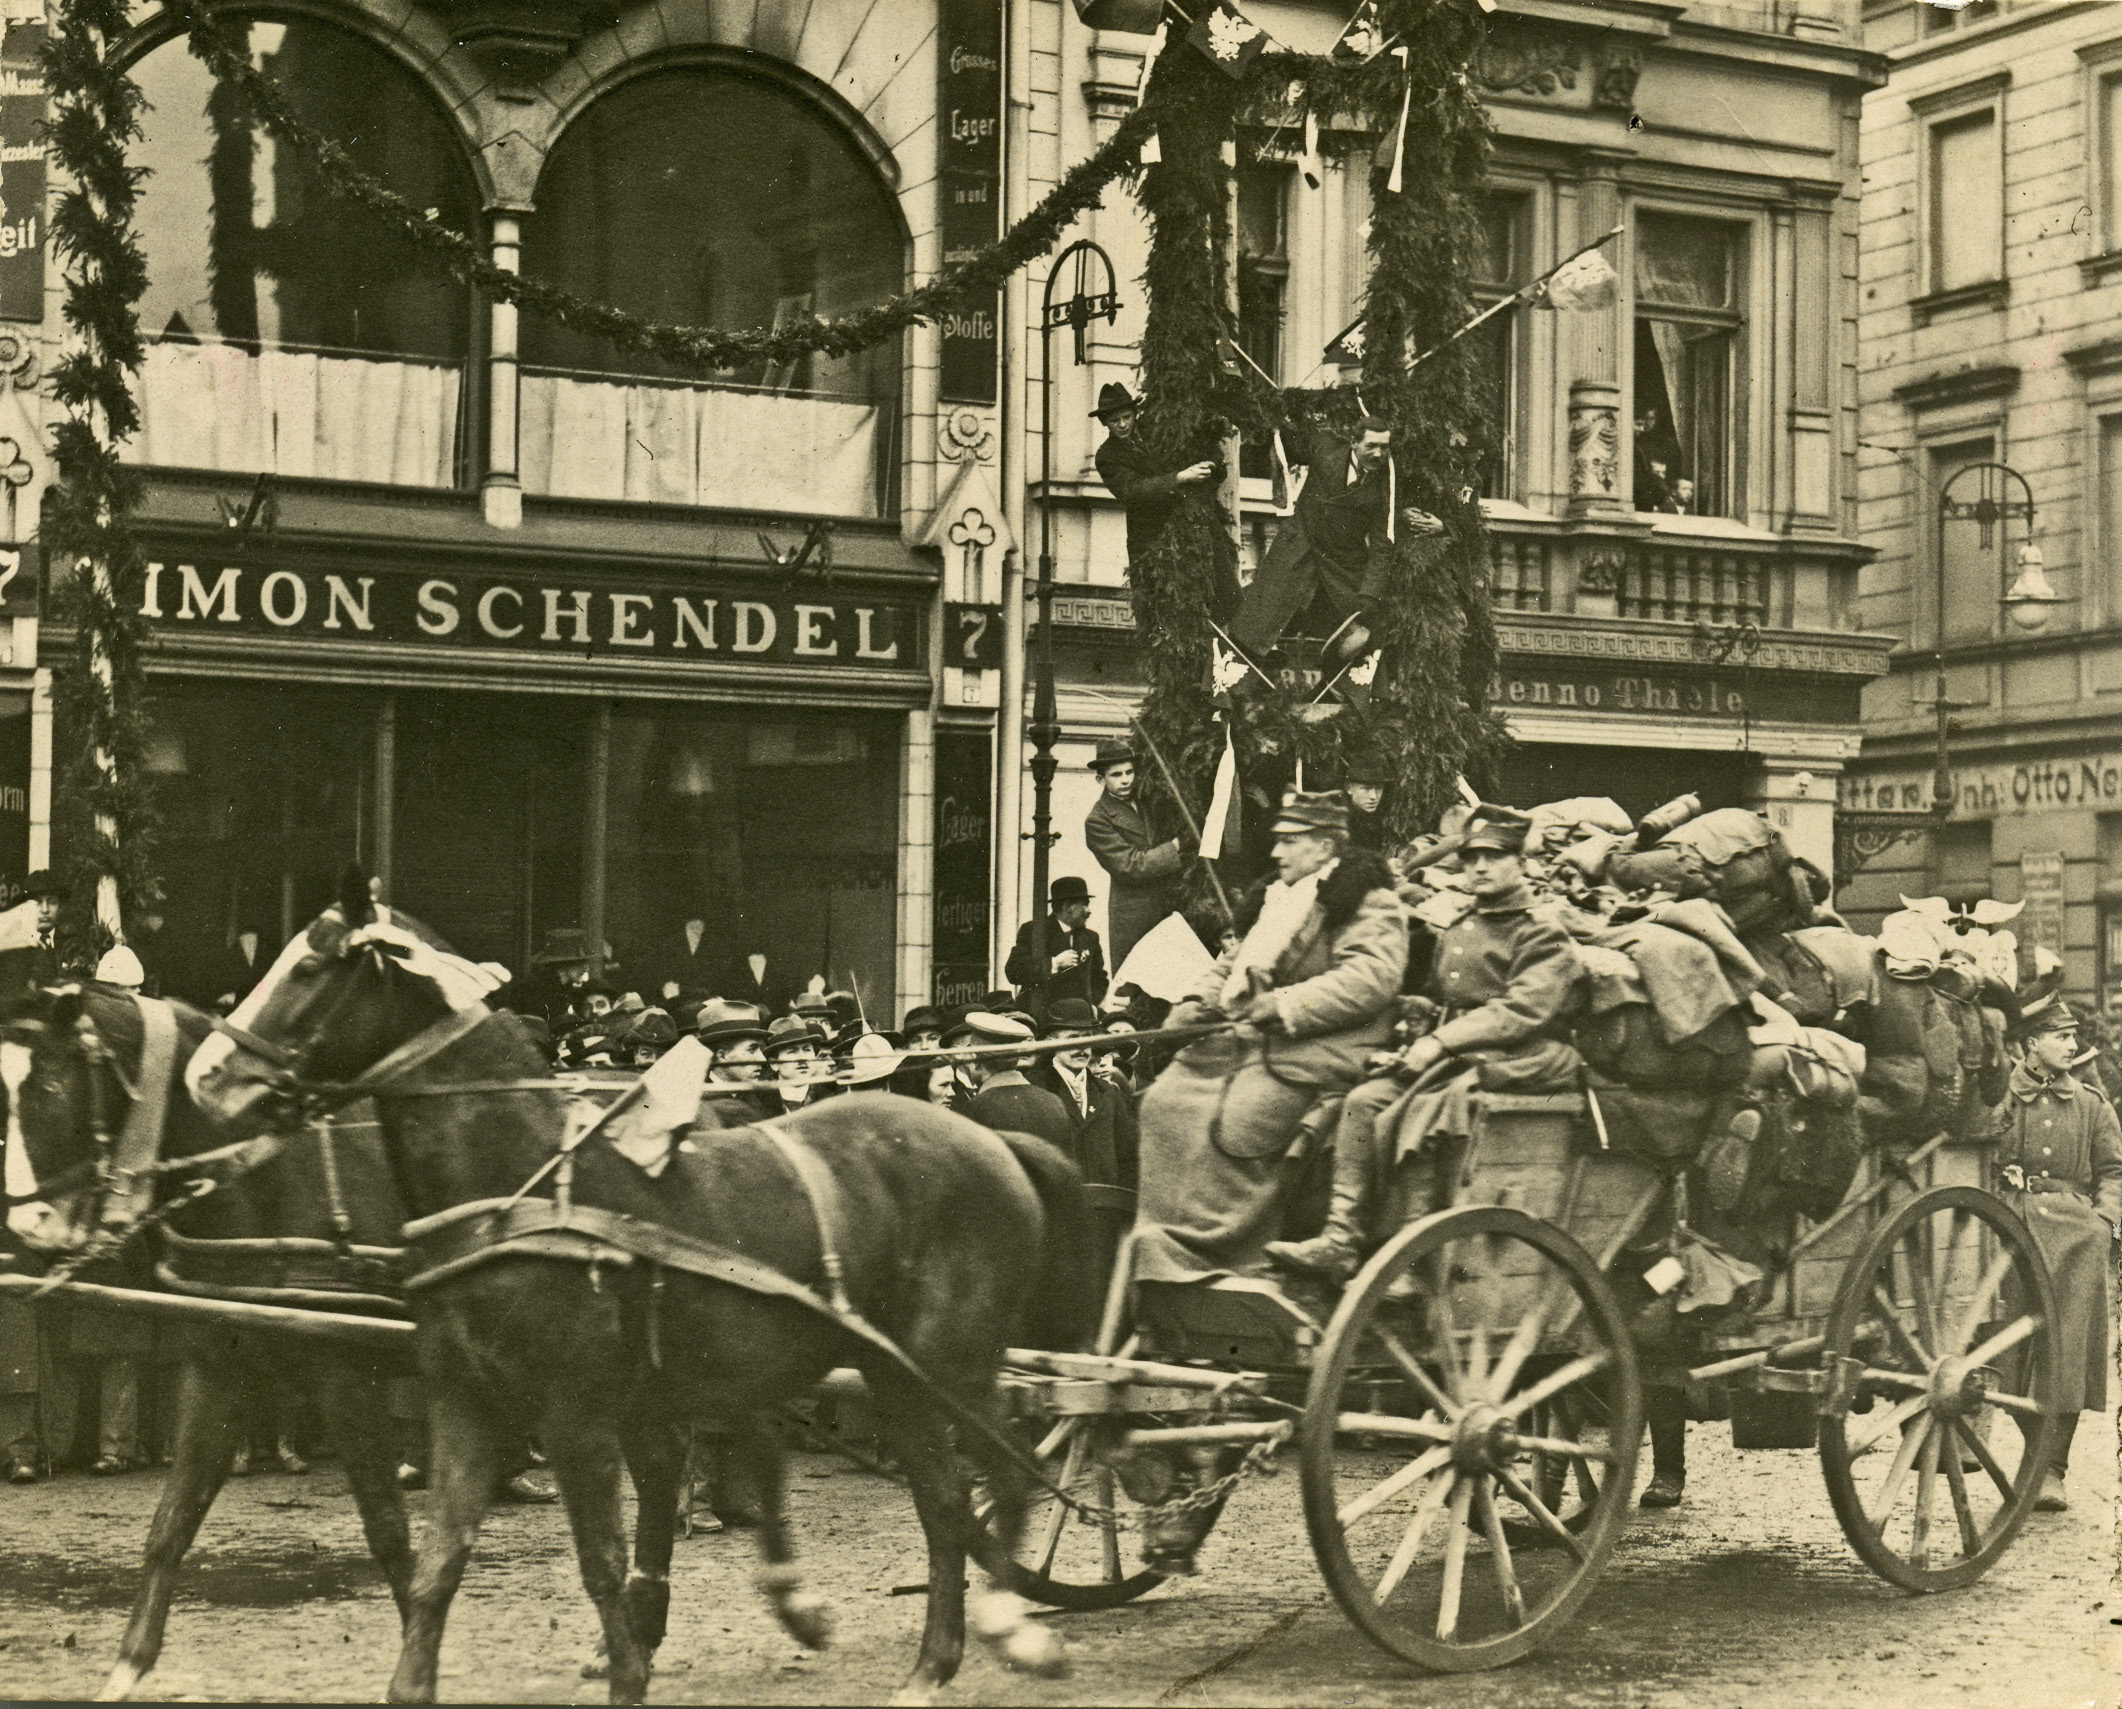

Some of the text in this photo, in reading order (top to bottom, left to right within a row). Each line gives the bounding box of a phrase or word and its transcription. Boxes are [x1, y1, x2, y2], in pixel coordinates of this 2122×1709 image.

[952, 109, 996, 145] Lager
[136, 562, 898, 660] IMON SCHENDEL
[959, 610, 988, 659] 7
[2012, 762, 2071, 806] Otto
[939, 796, 986, 848] Lager
